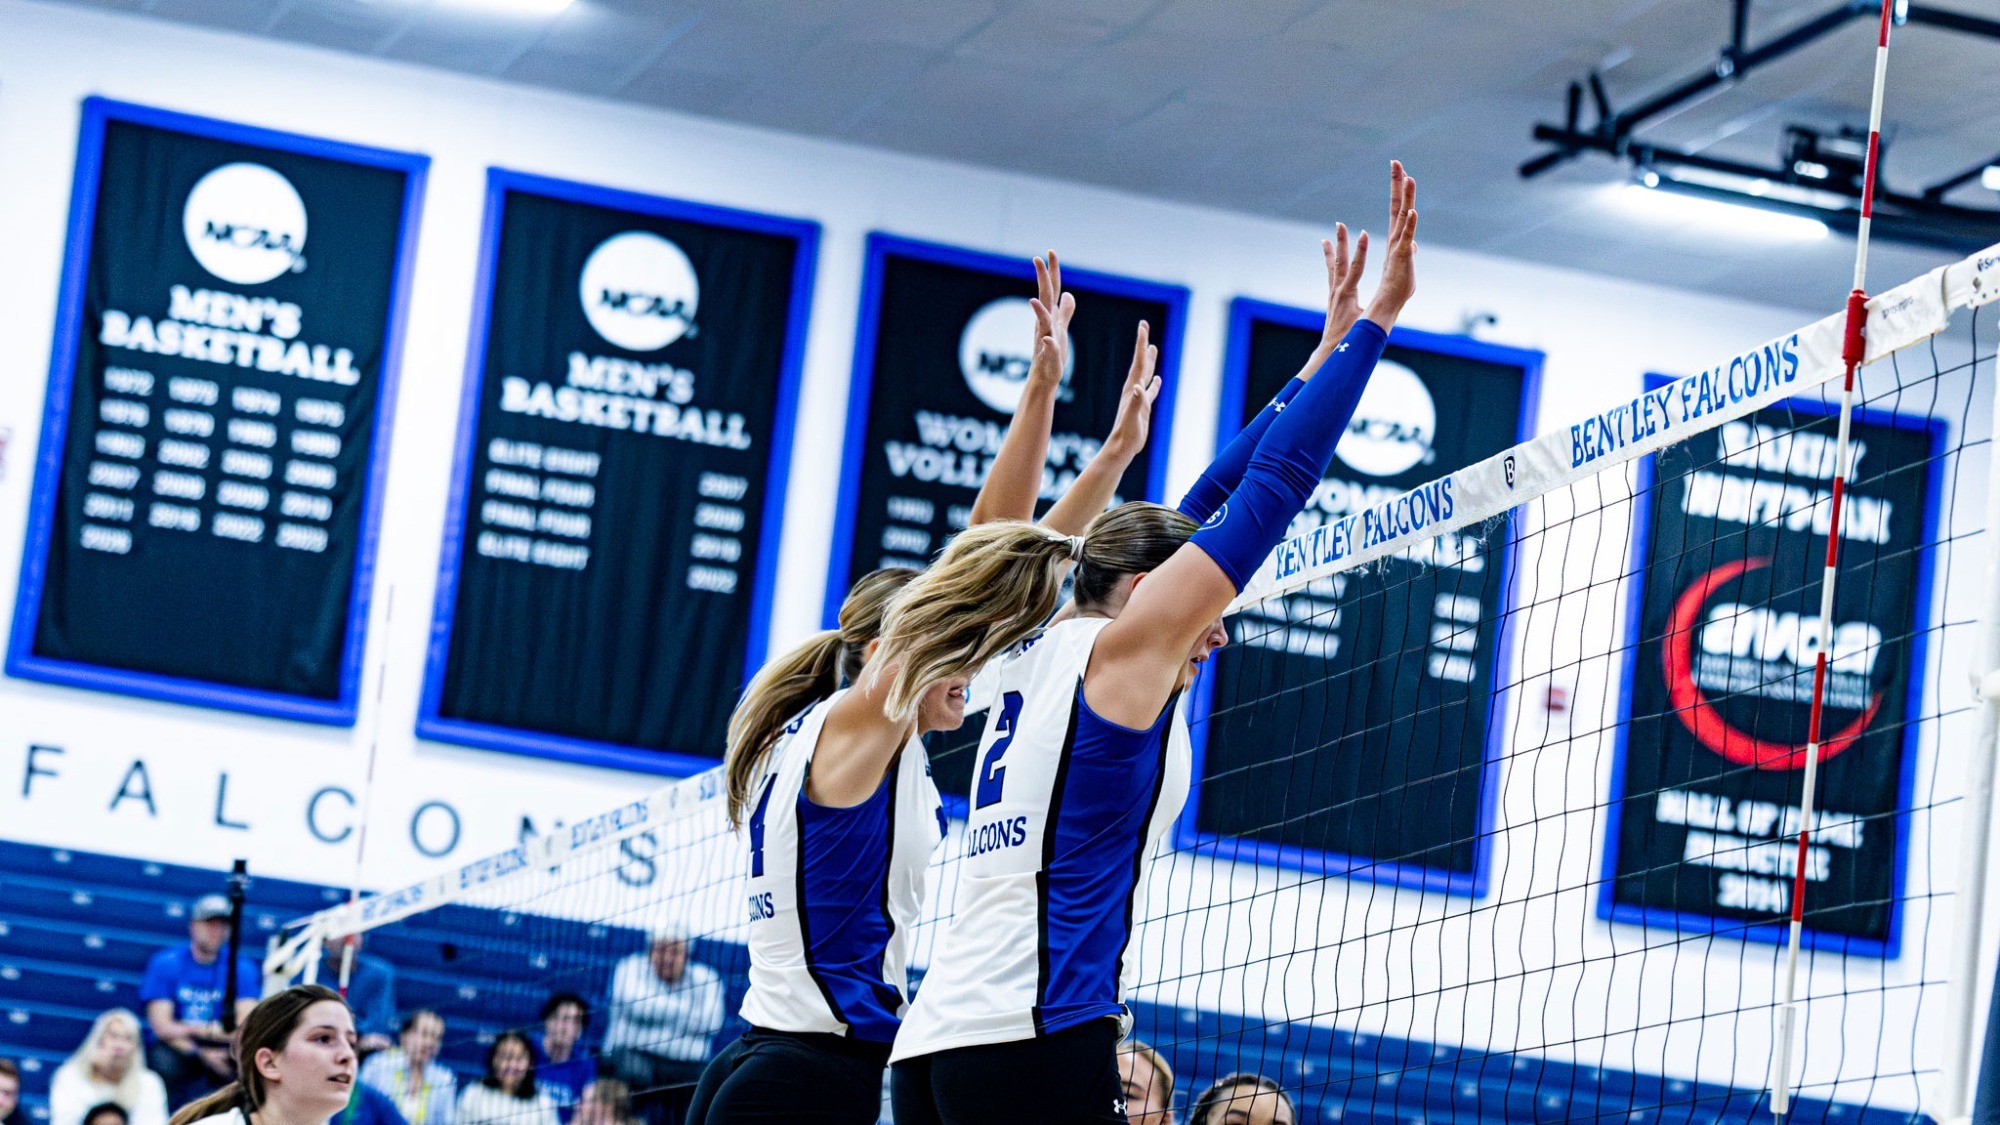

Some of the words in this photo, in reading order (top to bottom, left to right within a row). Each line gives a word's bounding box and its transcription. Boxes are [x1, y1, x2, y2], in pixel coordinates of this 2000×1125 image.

[99, 308, 361, 386] BASKETBALL
[168, 284, 302, 338] MEN'S
[500, 376, 751, 450] BASKETBALL
[566, 351, 695, 404] MEN'S
[1570, 384, 1674, 469] BENTLEY
[1681, 334, 1801, 424] FALCONS
[1362, 477, 1454, 549] FALCONS
[976, 690, 1024, 810] 2
